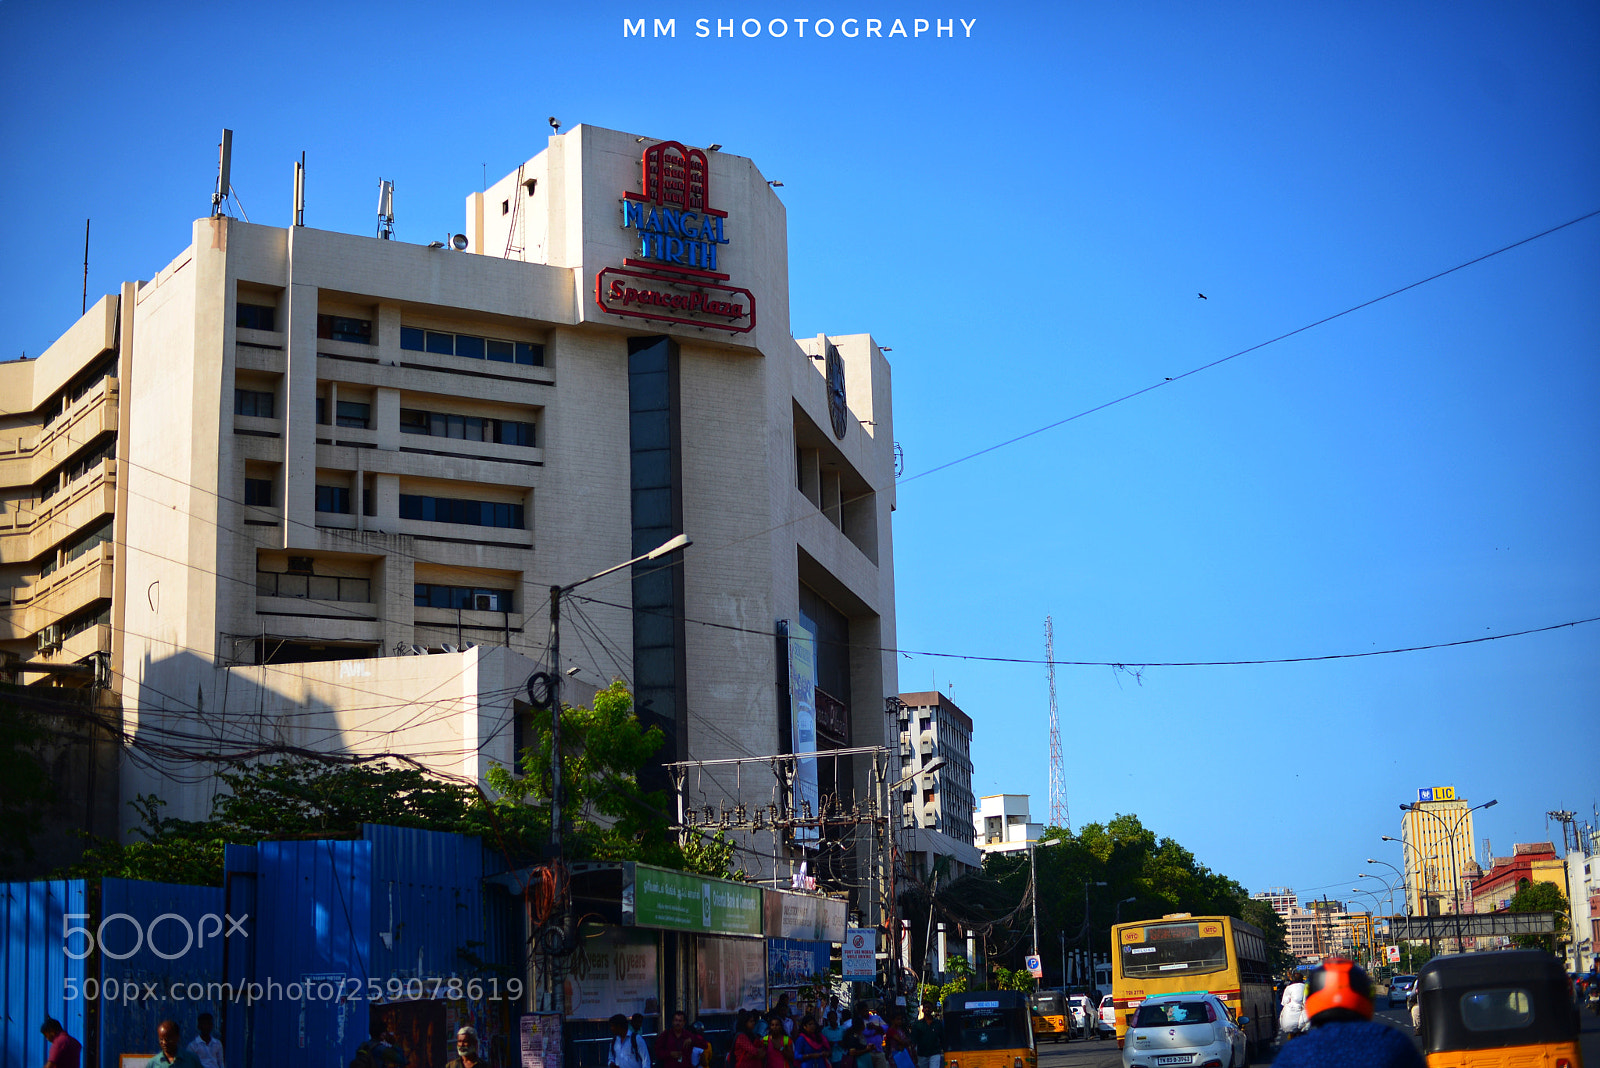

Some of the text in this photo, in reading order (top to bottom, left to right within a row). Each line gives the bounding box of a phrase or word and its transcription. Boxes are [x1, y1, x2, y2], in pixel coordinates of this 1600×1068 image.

[623, 200, 730, 245] MANGAL
[638, 231, 717, 271] TIRTH
[609, 279, 745, 317] Spencer Plaza
[1435, 788, 1453, 799] LIC
[626, 952, 646, 972] years
